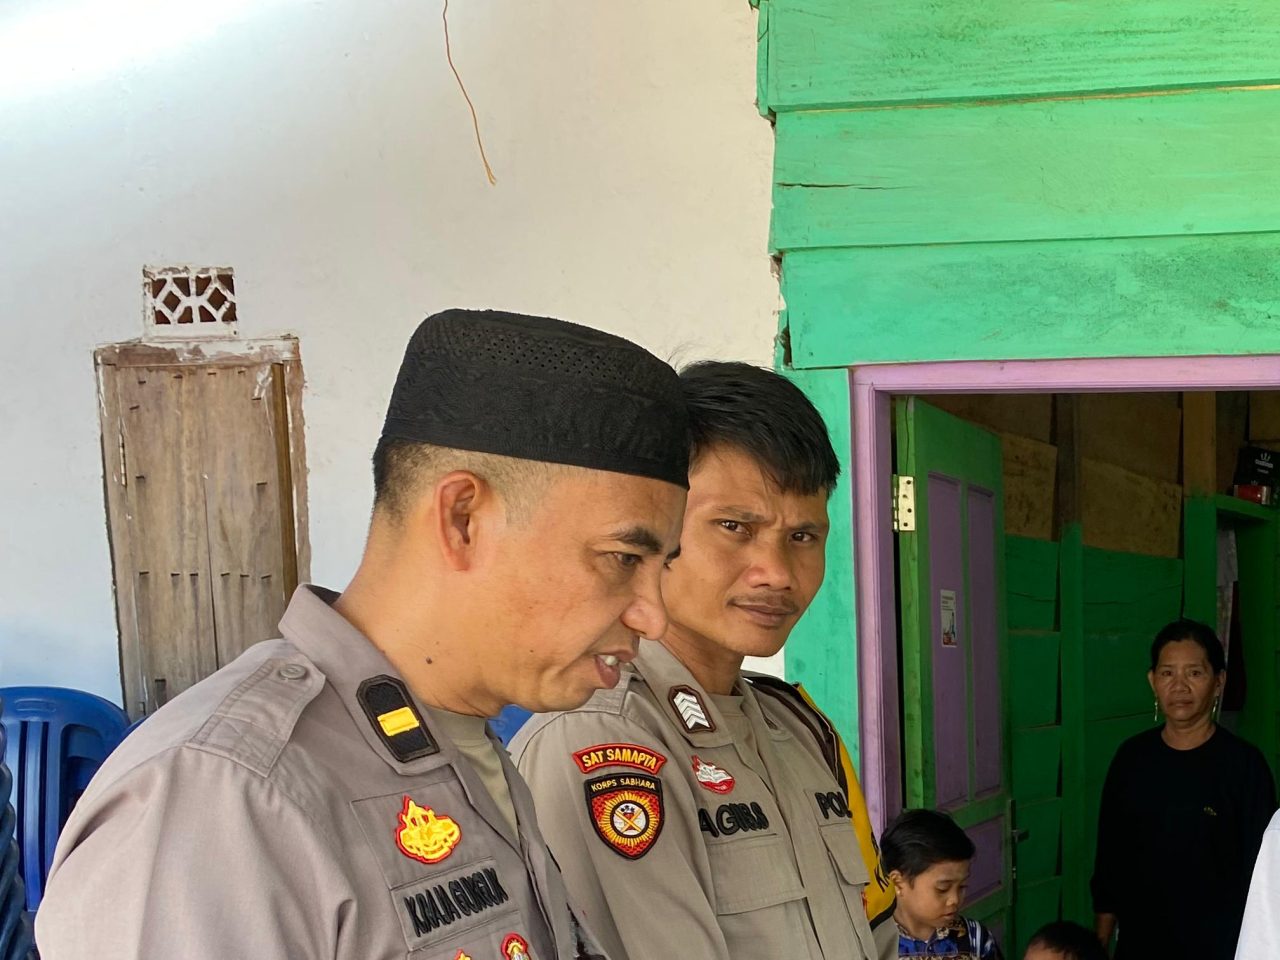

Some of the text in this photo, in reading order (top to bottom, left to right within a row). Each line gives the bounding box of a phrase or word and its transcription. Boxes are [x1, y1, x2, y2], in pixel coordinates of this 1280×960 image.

[582, 748, 657, 769] SAT SAMAPTA
[591, 778, 656, 792] KORPS SABHARA
